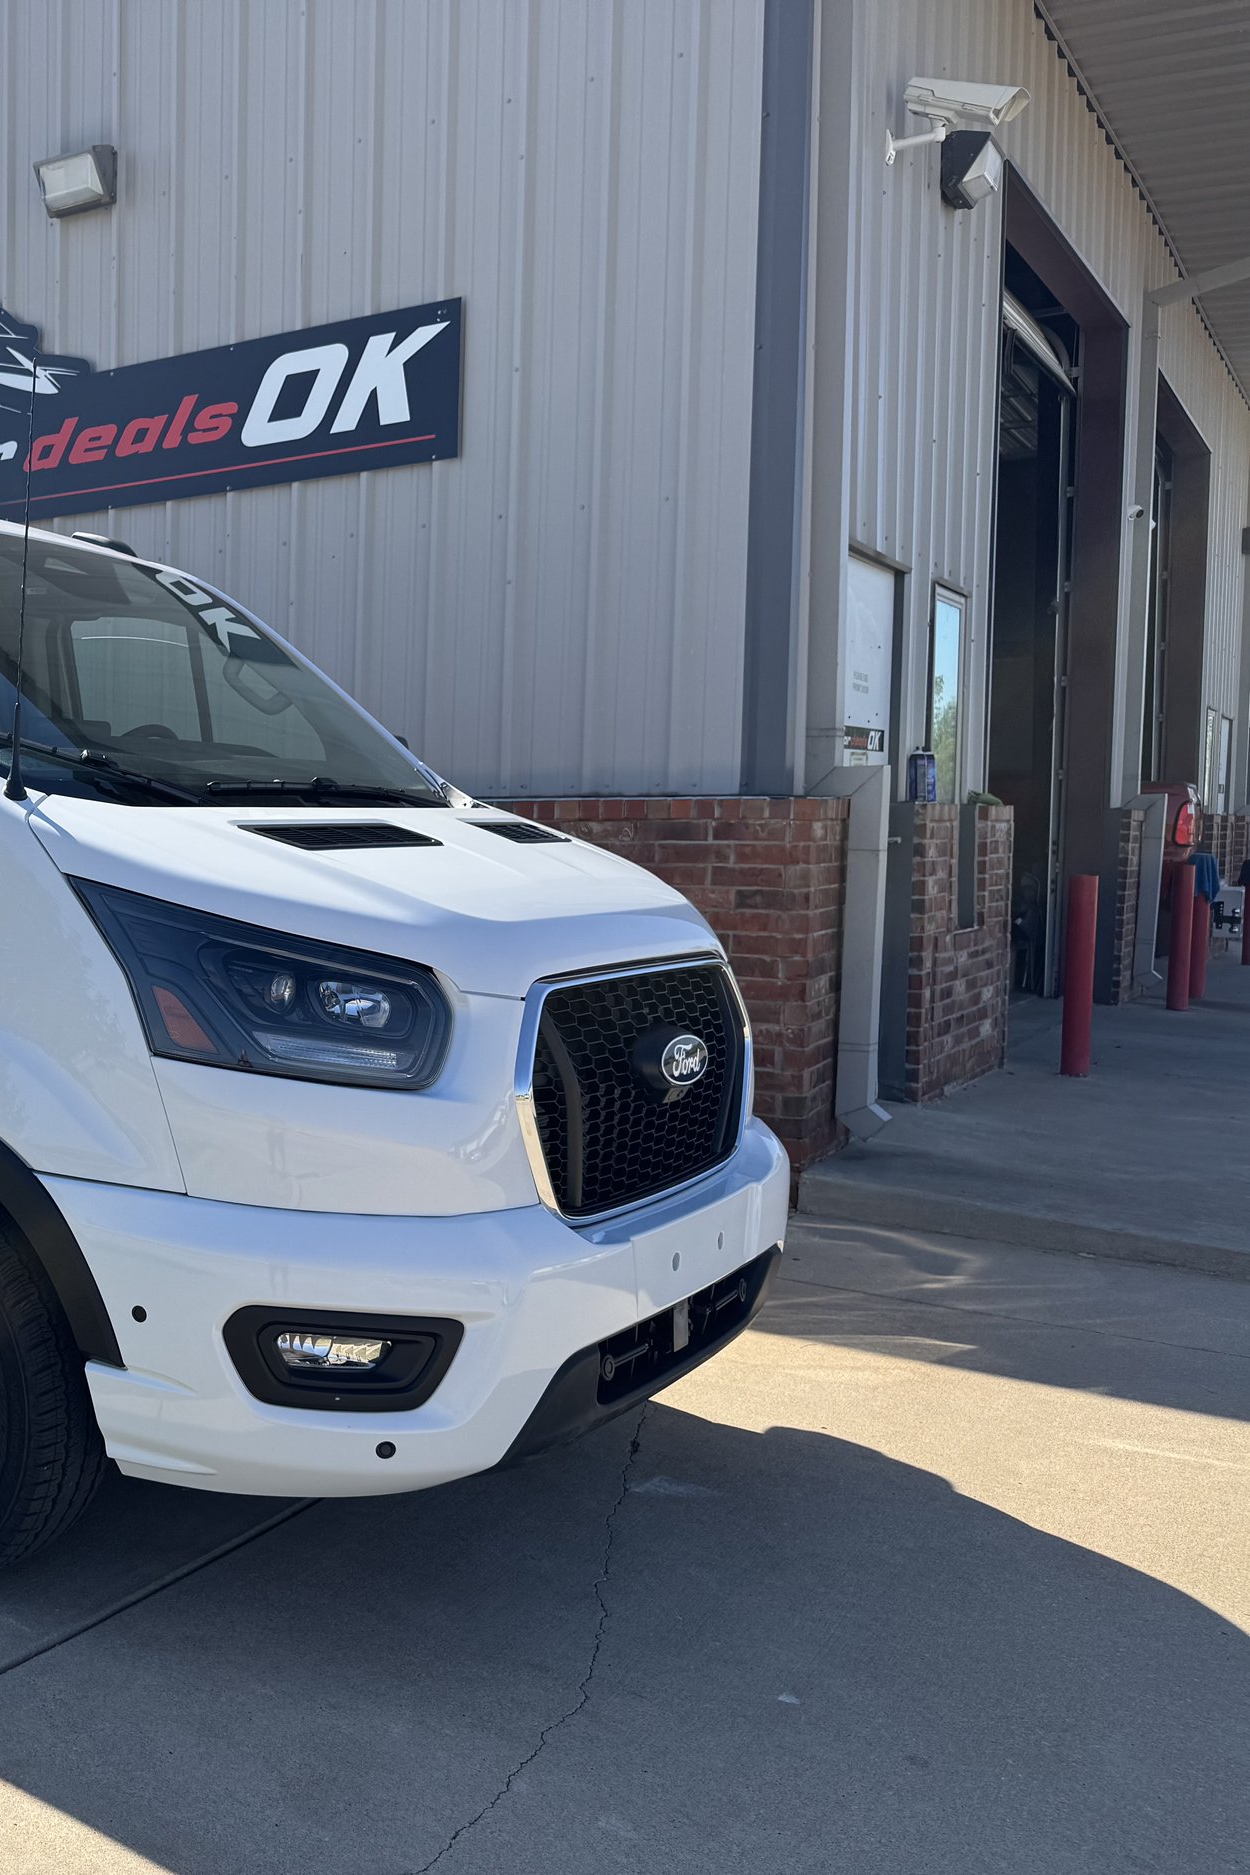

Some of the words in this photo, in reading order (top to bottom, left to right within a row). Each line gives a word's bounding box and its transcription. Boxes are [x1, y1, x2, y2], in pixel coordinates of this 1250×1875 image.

[22, 394, 238, 473] deals
[240, 320, 451, 448] OK
[867, 730, 882, 751] OK
[672, 1043, 701, 1077] Ford
